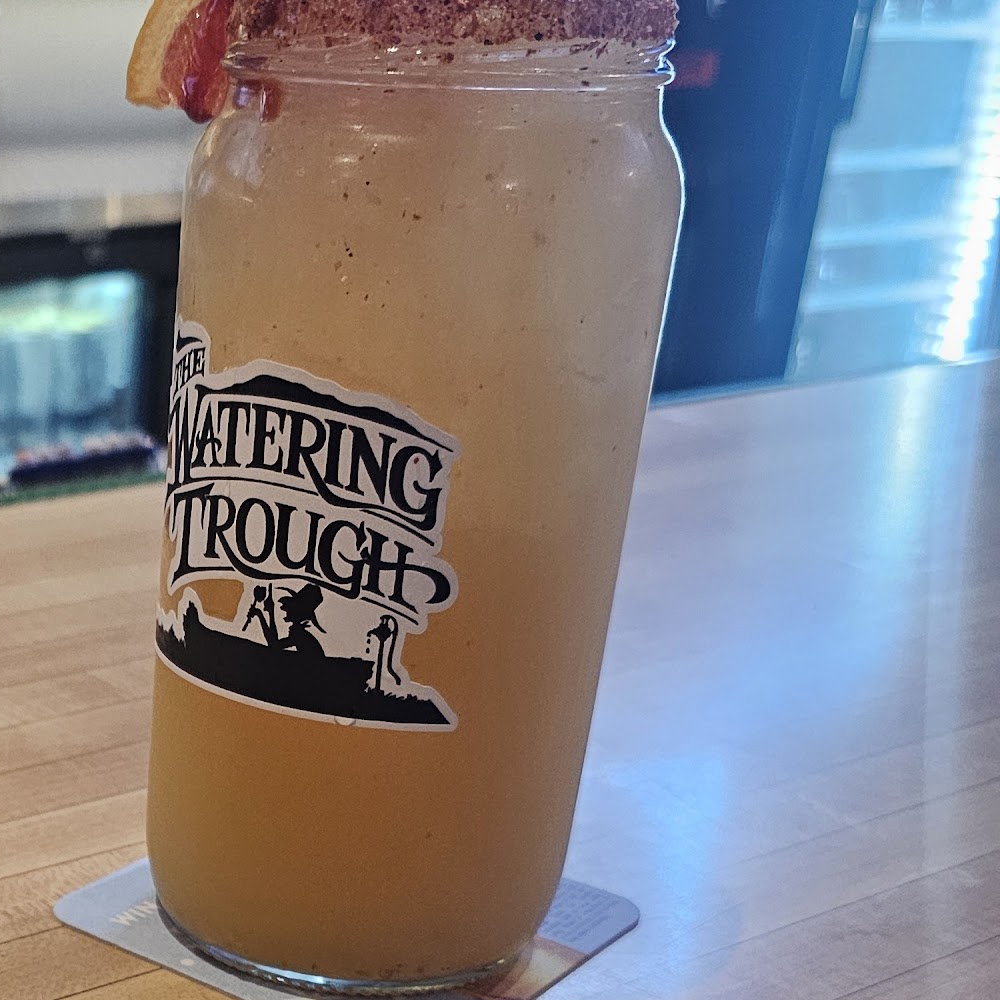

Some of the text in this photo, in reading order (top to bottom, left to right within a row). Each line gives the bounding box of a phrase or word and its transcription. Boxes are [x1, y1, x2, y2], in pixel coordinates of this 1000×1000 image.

[173, 346, 206, 396] THE
[167, 383, 443, 532] WATERING
[171, 483, 451, 614] TROUGH
